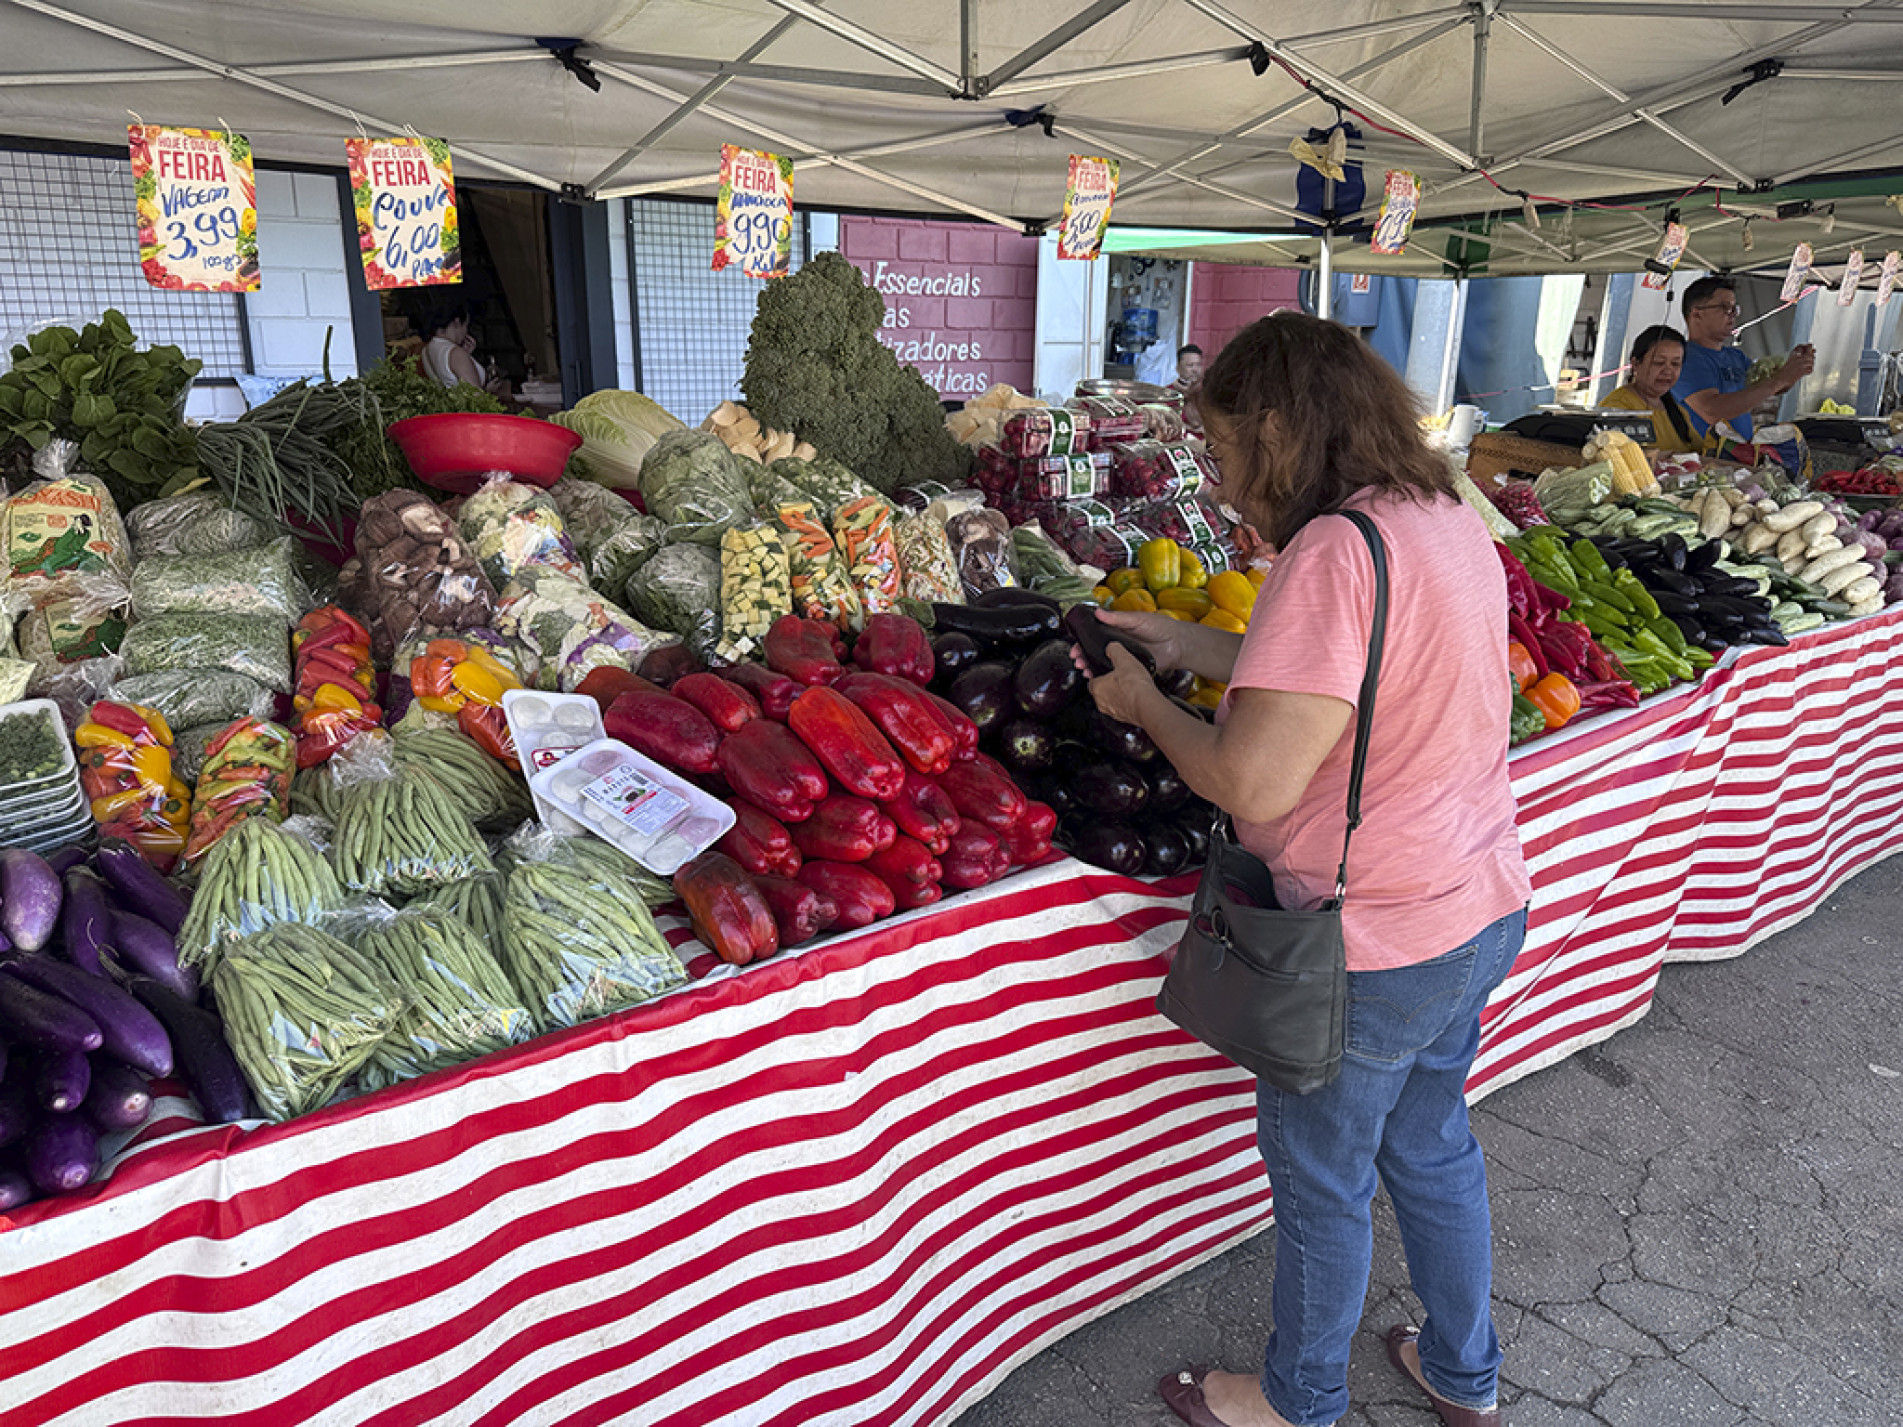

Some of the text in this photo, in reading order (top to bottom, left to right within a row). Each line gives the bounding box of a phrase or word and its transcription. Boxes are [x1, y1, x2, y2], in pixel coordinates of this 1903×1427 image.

[158, 150, 226, 182] FEIRA
[372, 160, 430, 186] FEIRA
[735, 165, 776, 193] FEIRA
[1078, 170, 1106, 191] FEIRA
[167, 206, 240, 260] 3,99
[385, 223, 439, 269] 6,00
